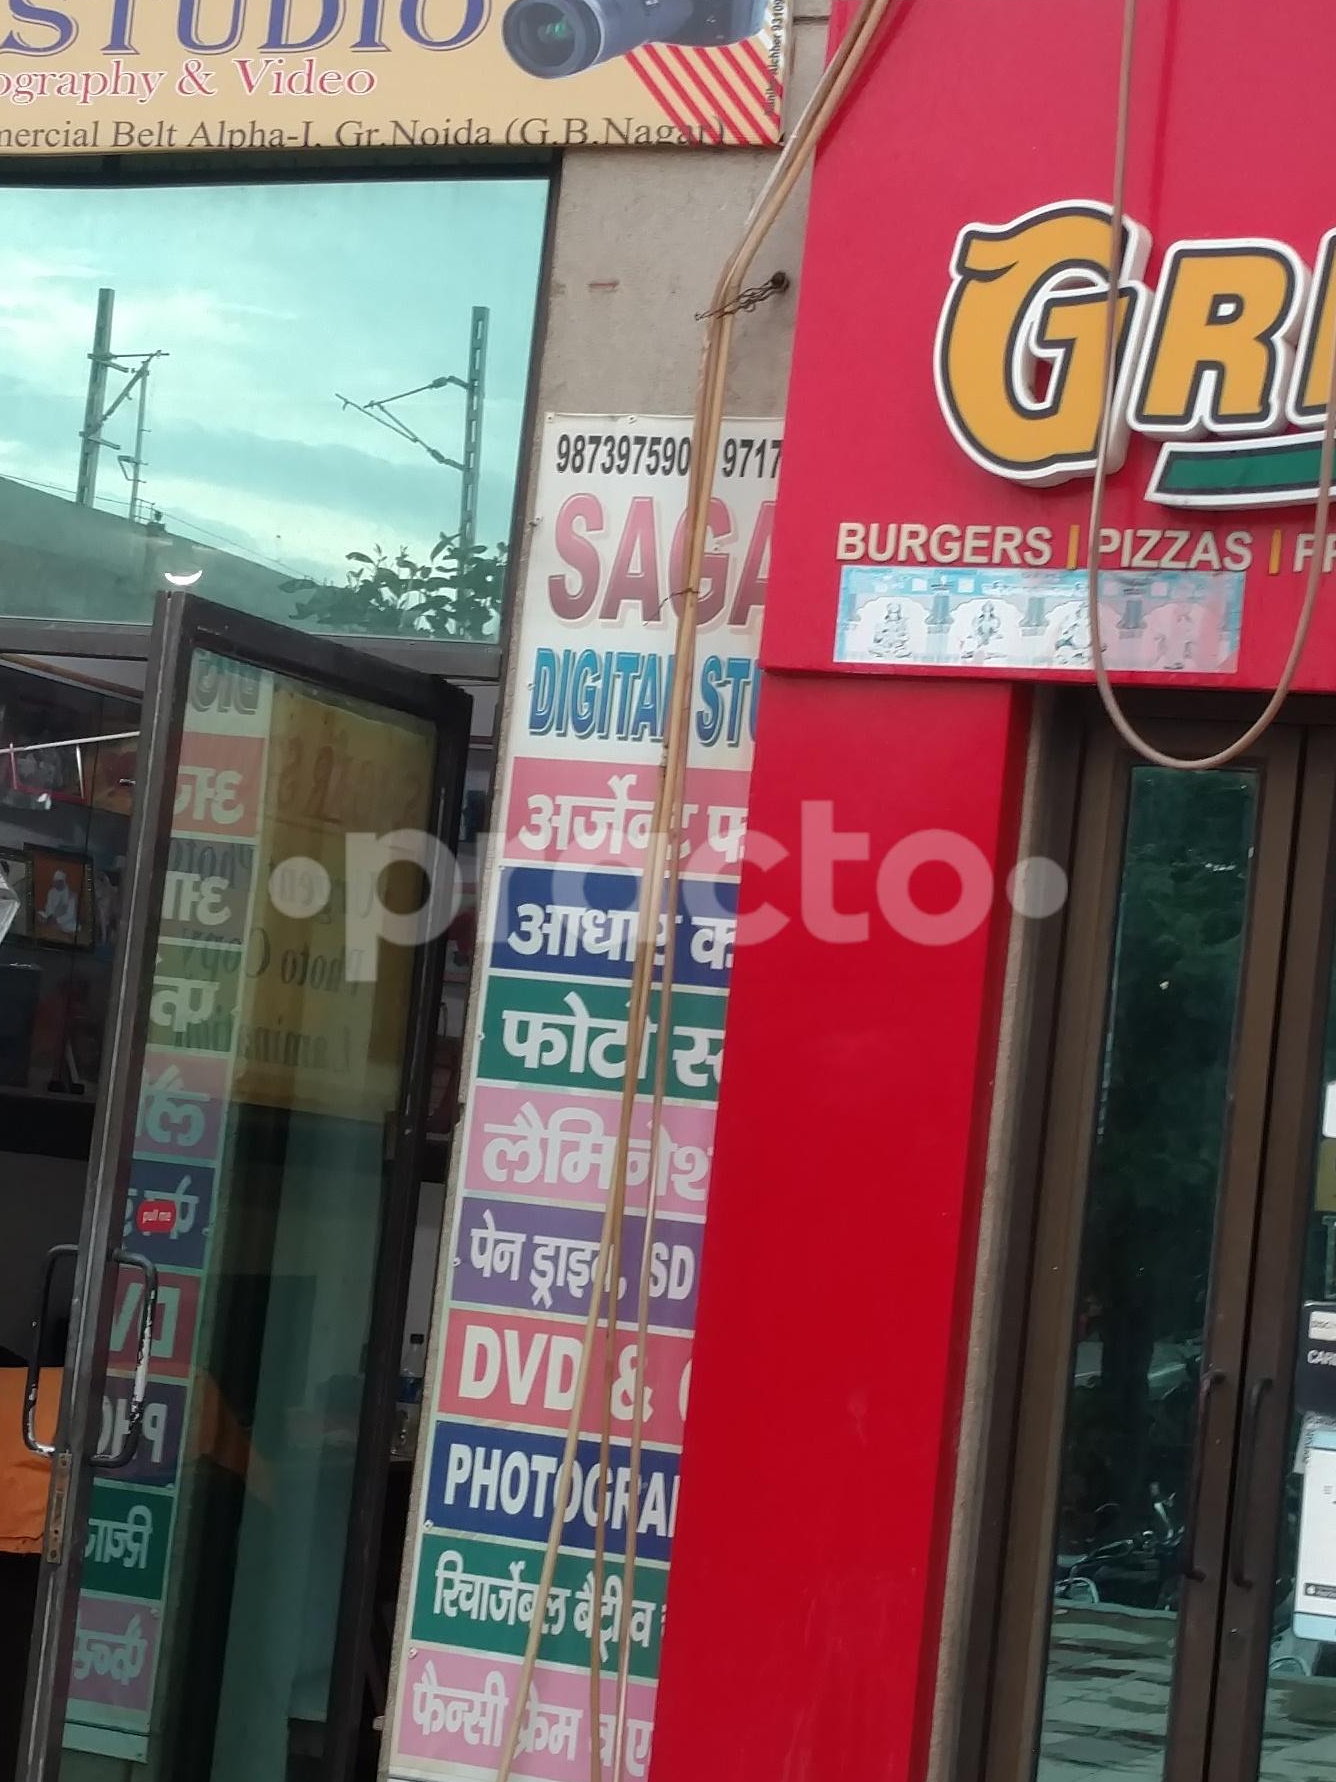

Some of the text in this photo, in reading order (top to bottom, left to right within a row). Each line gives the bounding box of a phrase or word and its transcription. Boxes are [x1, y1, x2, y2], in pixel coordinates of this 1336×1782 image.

[176, 58, 218, 98] &
[232, 57, 377, 97] Video
[111, 120, 179, 148] Belt
[835, 522, 1054, 567] BURGERS
[1098, 527, 1255, 573] PIZZAS
[458, 1325, 583, 1411] DVD
